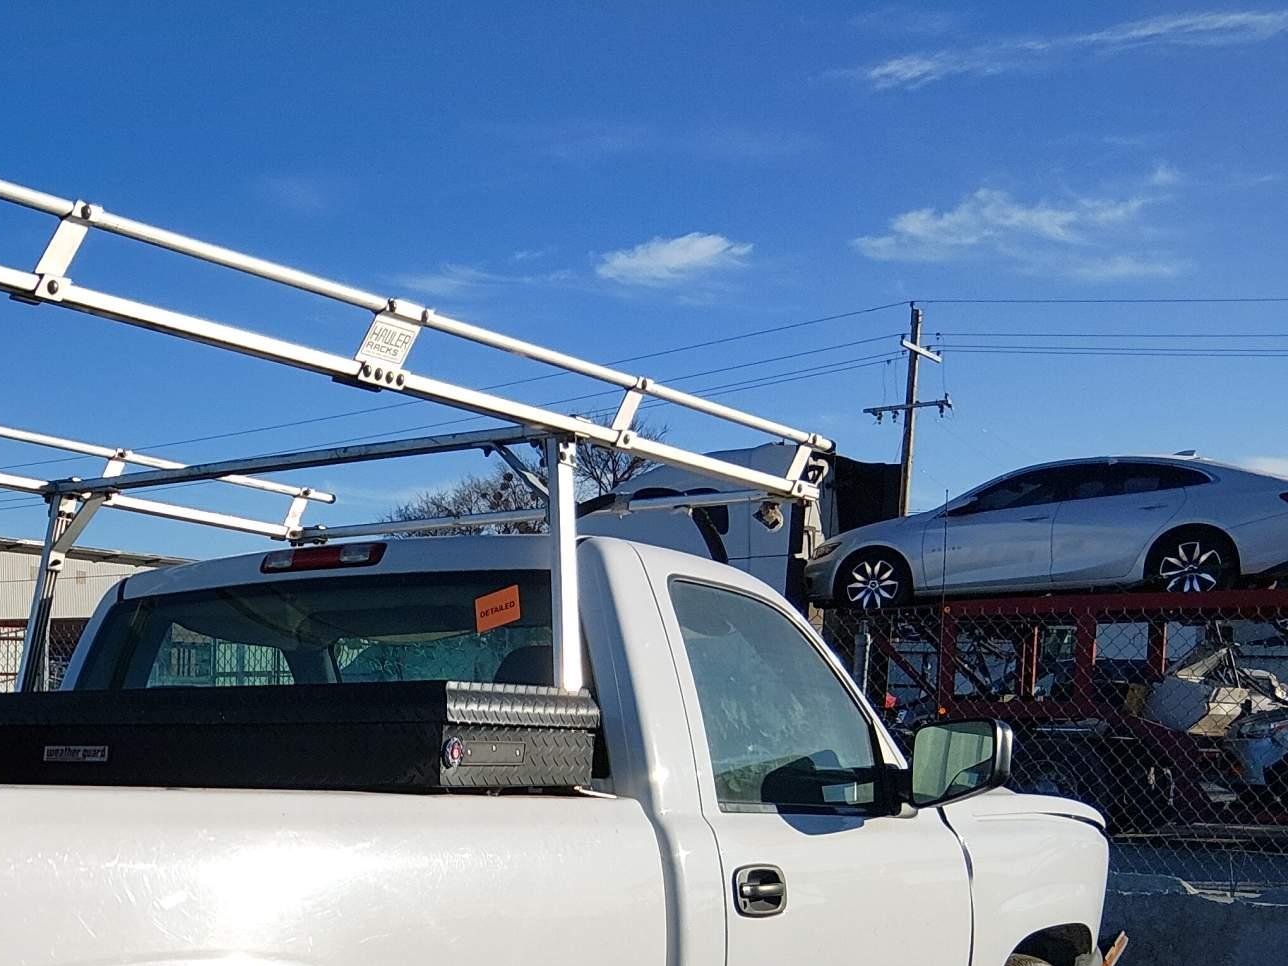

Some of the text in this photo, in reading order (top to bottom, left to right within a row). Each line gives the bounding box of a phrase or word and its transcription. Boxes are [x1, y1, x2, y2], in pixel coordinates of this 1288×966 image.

[369, 325, 411, 350] HAULER
[365, 341, 399, 357] RACKS
[479, 600, 516, 618] DETAILED
